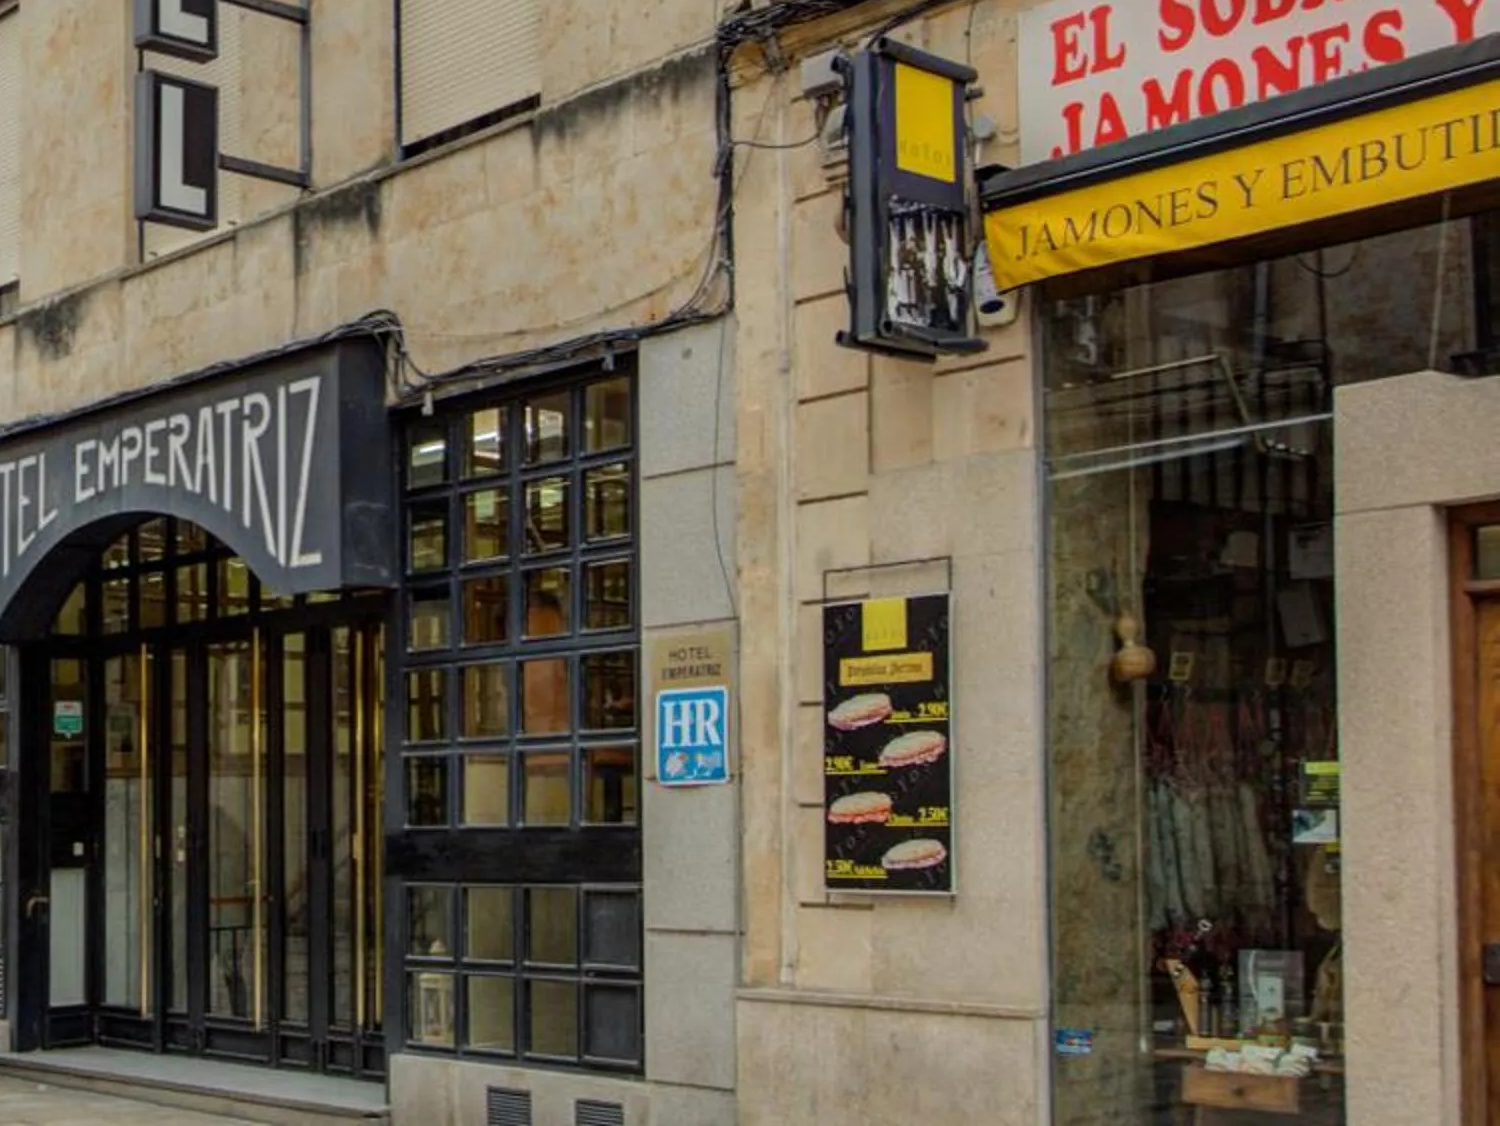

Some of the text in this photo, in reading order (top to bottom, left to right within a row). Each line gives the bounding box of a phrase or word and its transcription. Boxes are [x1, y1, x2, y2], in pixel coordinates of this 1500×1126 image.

[1050, 5, 1126, 86] EL
[1015, 180, 1218, 261] JAMONES
[1234, 168, 1266, 210] Y
[74, 376, 322, 569] EMPERATRIZ
[661, 663, 722, 681] EMPERATRIZ
[668, 647, 712, 661] HOTEL
[660, 697, 722, 748] HR
